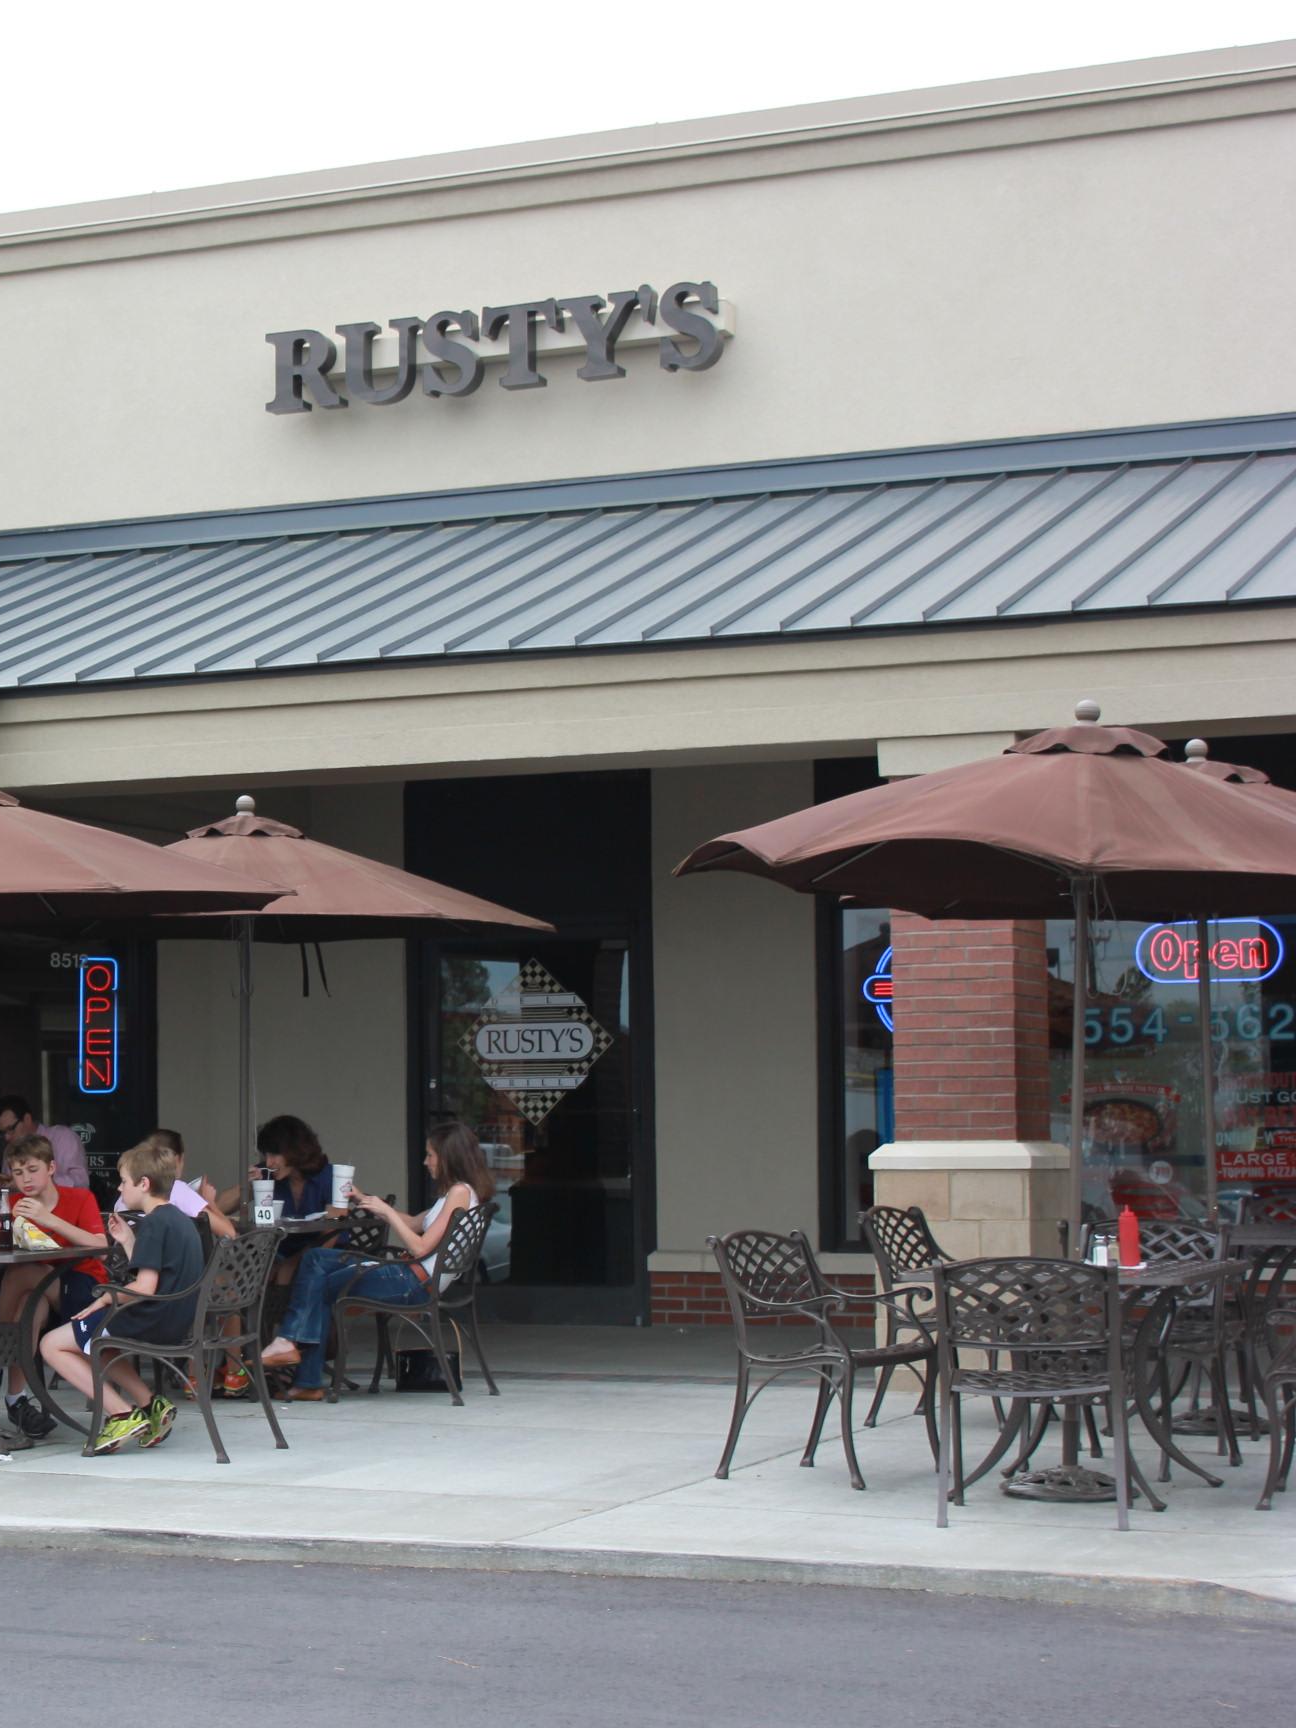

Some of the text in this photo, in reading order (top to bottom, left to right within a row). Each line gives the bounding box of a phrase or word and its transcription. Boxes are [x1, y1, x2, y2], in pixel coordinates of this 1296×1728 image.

[265, 280, 726, 416] RUSTY'S
[1150, 929, 1269, 980] Open
[85, 965, 112, 1086] OPEN
[485, 1027, 584, 1055] RUSTY'S
[1216, 1167, 1265, 1178] -TOPPING
[1221, 1153, 1287, 1166] LARGE
[258, 1210, 271, 1220] 40
